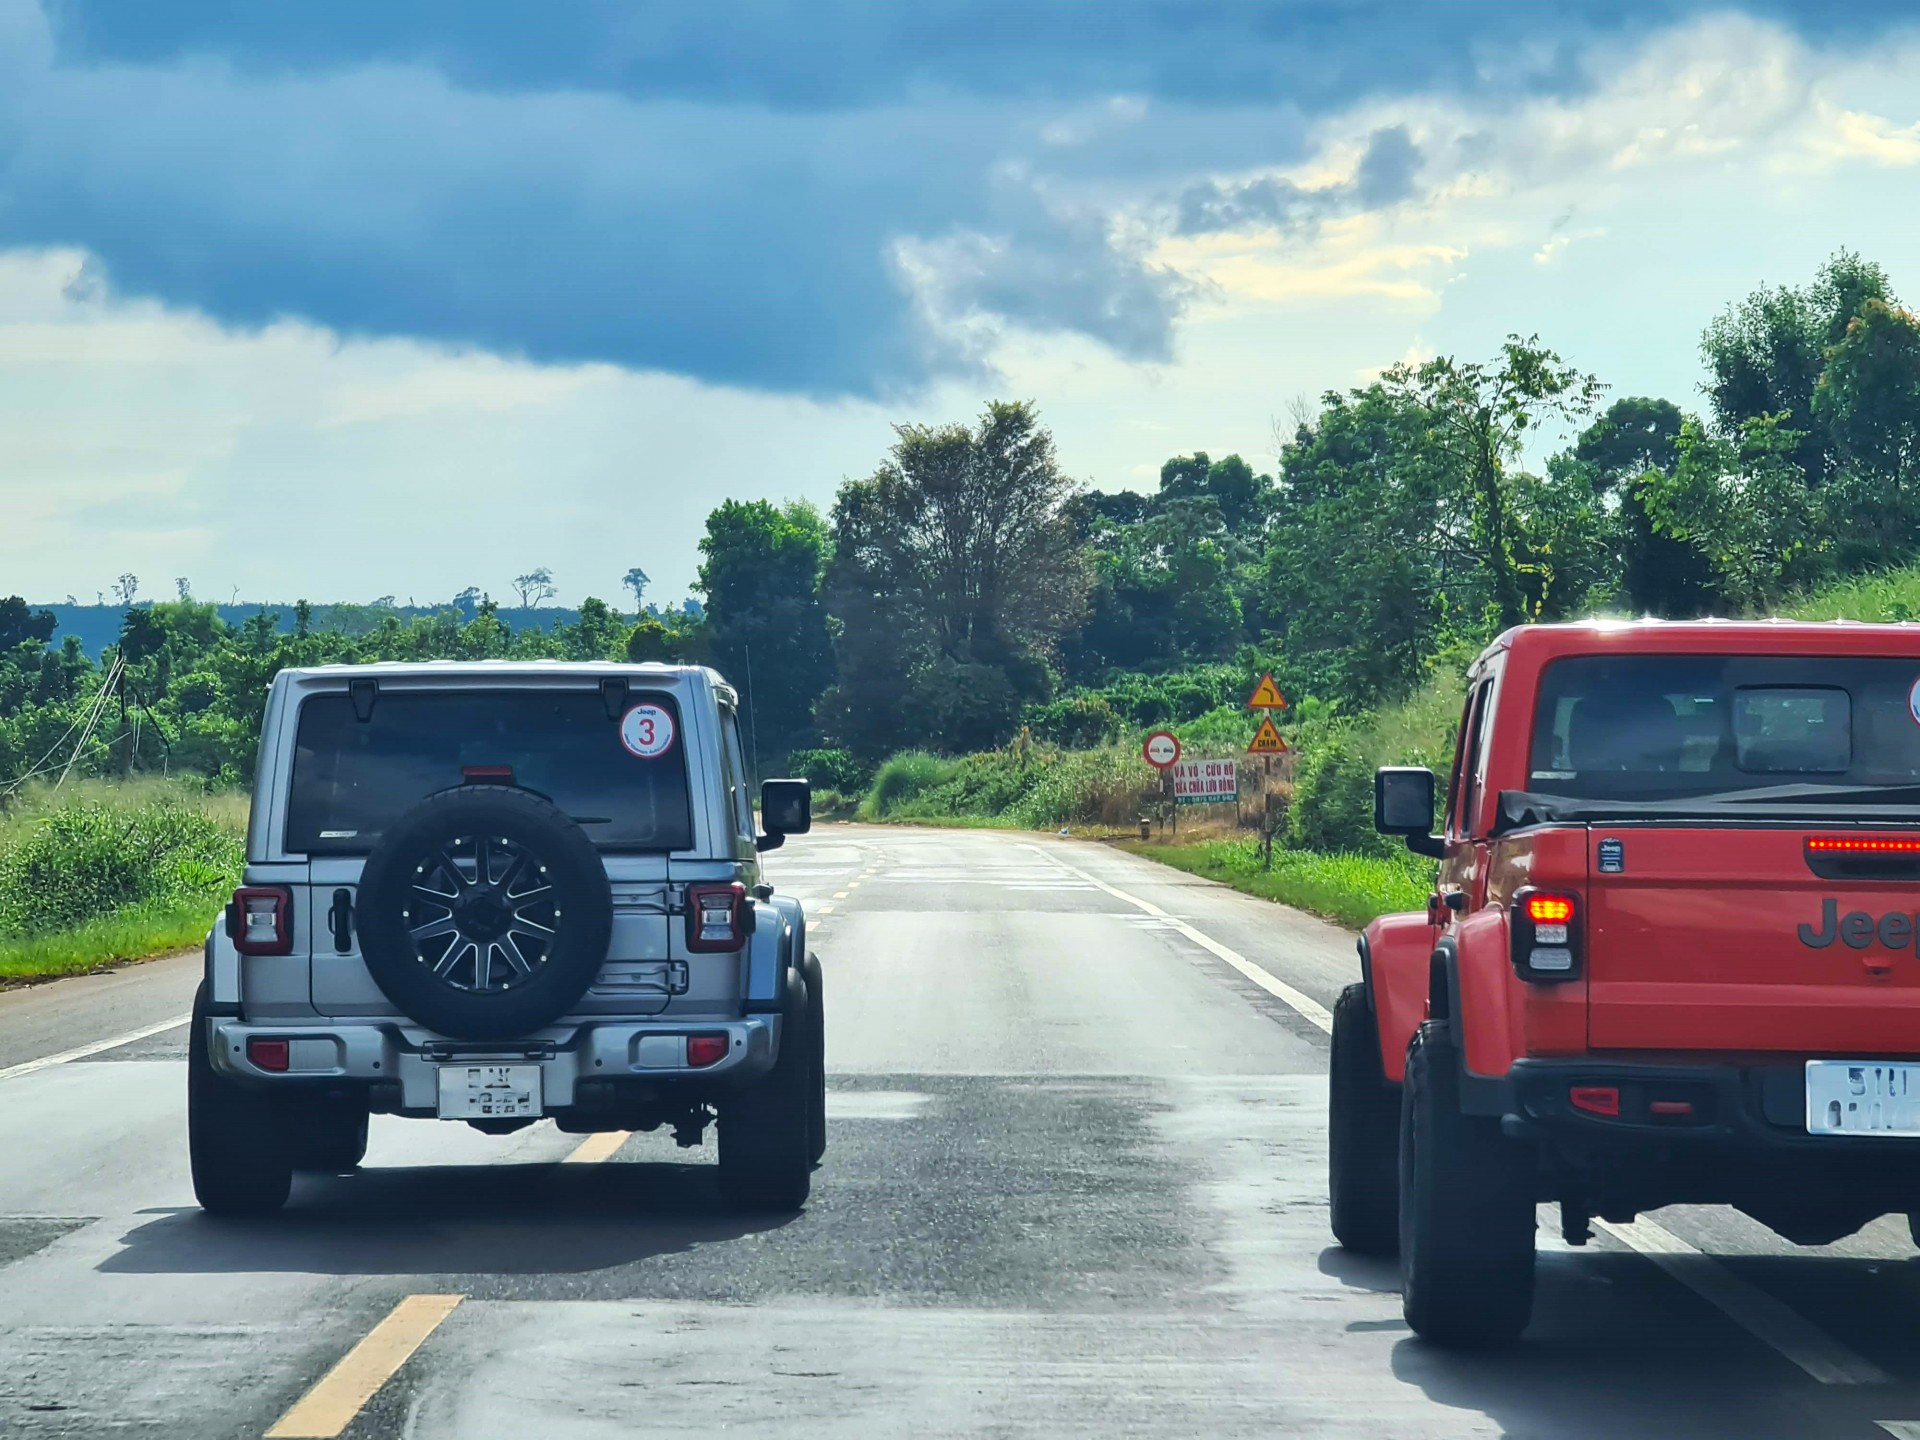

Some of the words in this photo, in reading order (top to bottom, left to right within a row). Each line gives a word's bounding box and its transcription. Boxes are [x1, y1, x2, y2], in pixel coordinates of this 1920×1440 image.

[638, 708, 657, 716] Jeep
[638, 718, 655, 746] 3
[1797, 898, 1920, 961] Jee
